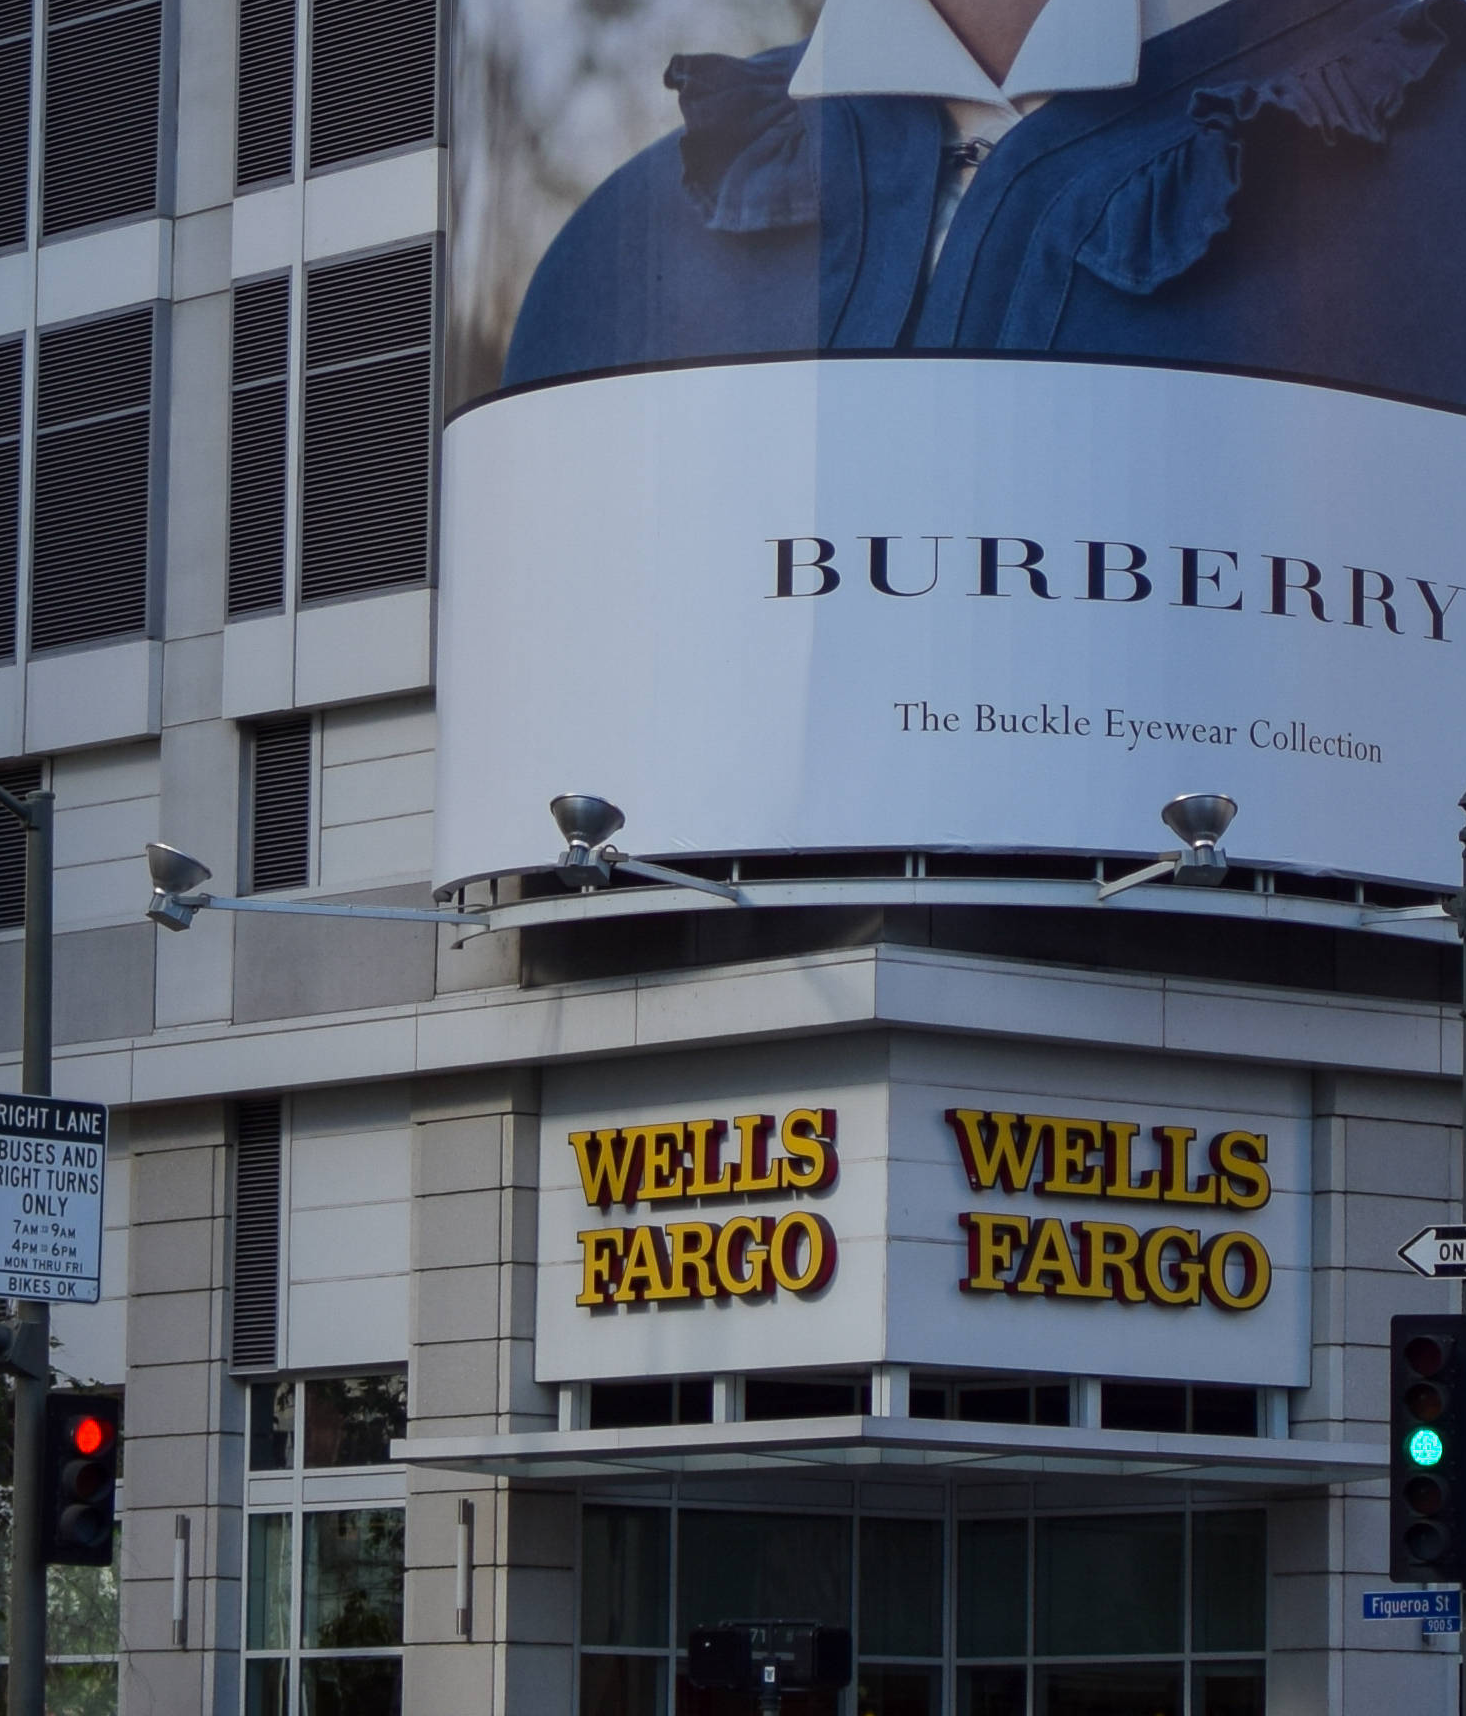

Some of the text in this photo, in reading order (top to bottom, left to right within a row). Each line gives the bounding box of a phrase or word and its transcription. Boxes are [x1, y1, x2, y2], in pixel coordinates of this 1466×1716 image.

[764, 534, 1466, 644] BURBERRY
[894, 701, 1384, 764] The Buckle Eyewear Collection
[55, 1109, 102, 1135] LANE
[62, 1146, 98, 1169] AND
[568, 1108, 838, 1207] WELLS
[944, 1108, 1271, 1211] WELLS
[46, 1169, 99, 1195] TURNS
[22, 1193, 68, 1217] ONLY
[13, 1219, 38, 1235] 7AM
[51, 1223, 76, 1238] 9AM
[12, 1239, 38, 1254] 4PM
[51, 1242, 77, 1258] 6PM
[576, 1210, 837, 1307] FARGO
[958, 1211, 1272, 1312] FARGO
[4, 1256, 83, 1274] MON THRU FRI
[8, 1277, 76, 1297] BIKES OK
[1372, 1595, 1450, 1618] Figueroa St
